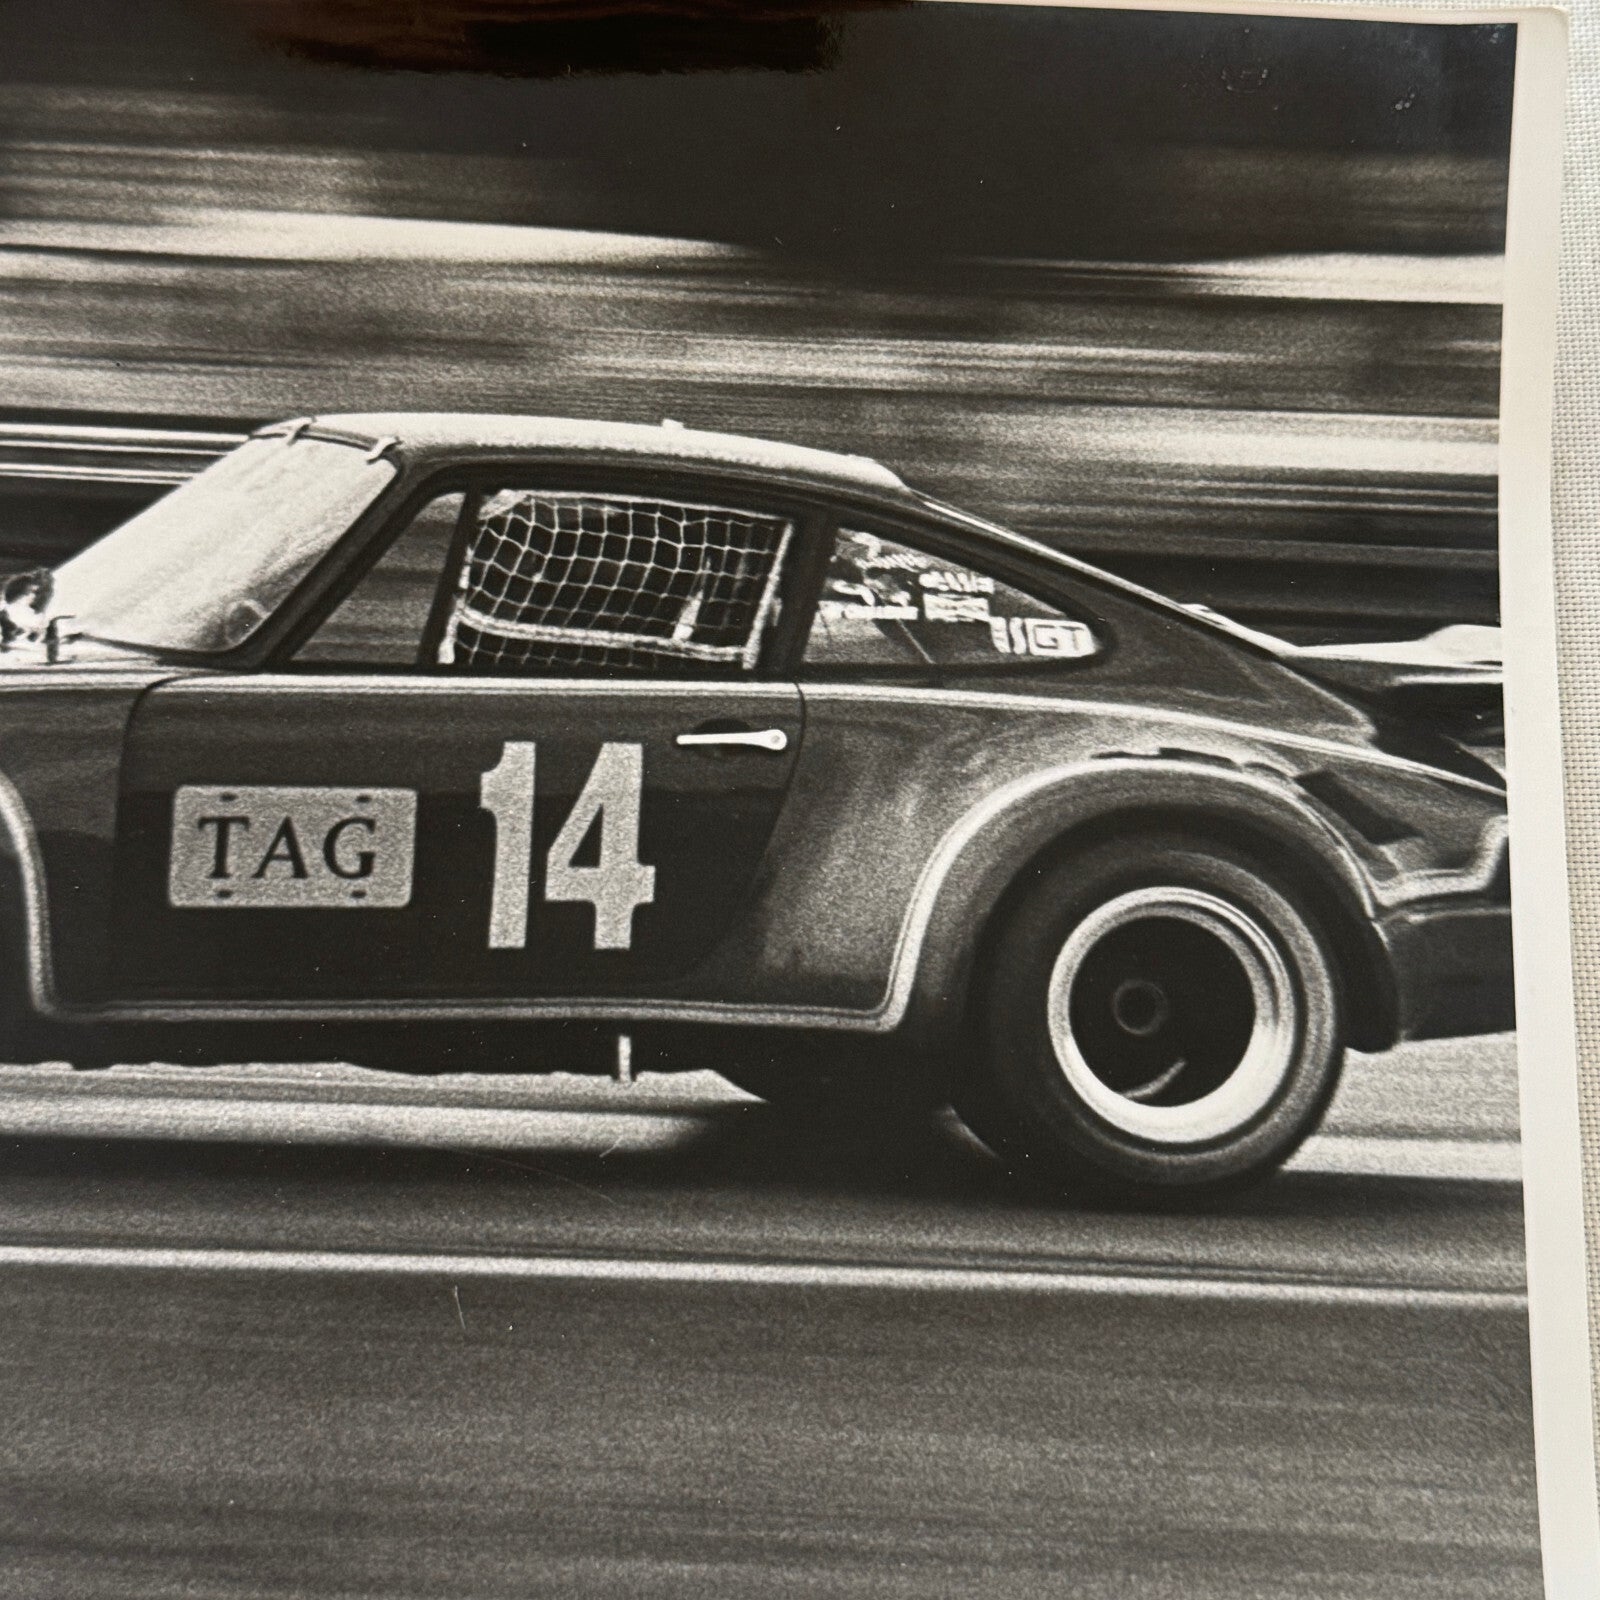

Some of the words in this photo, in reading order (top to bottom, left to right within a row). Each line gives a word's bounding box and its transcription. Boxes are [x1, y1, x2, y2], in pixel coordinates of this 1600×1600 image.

[1033, 622, 1085, 650] GT
[198, 815, 377, 880] TAG
[480, 741, 656, 949] 14
